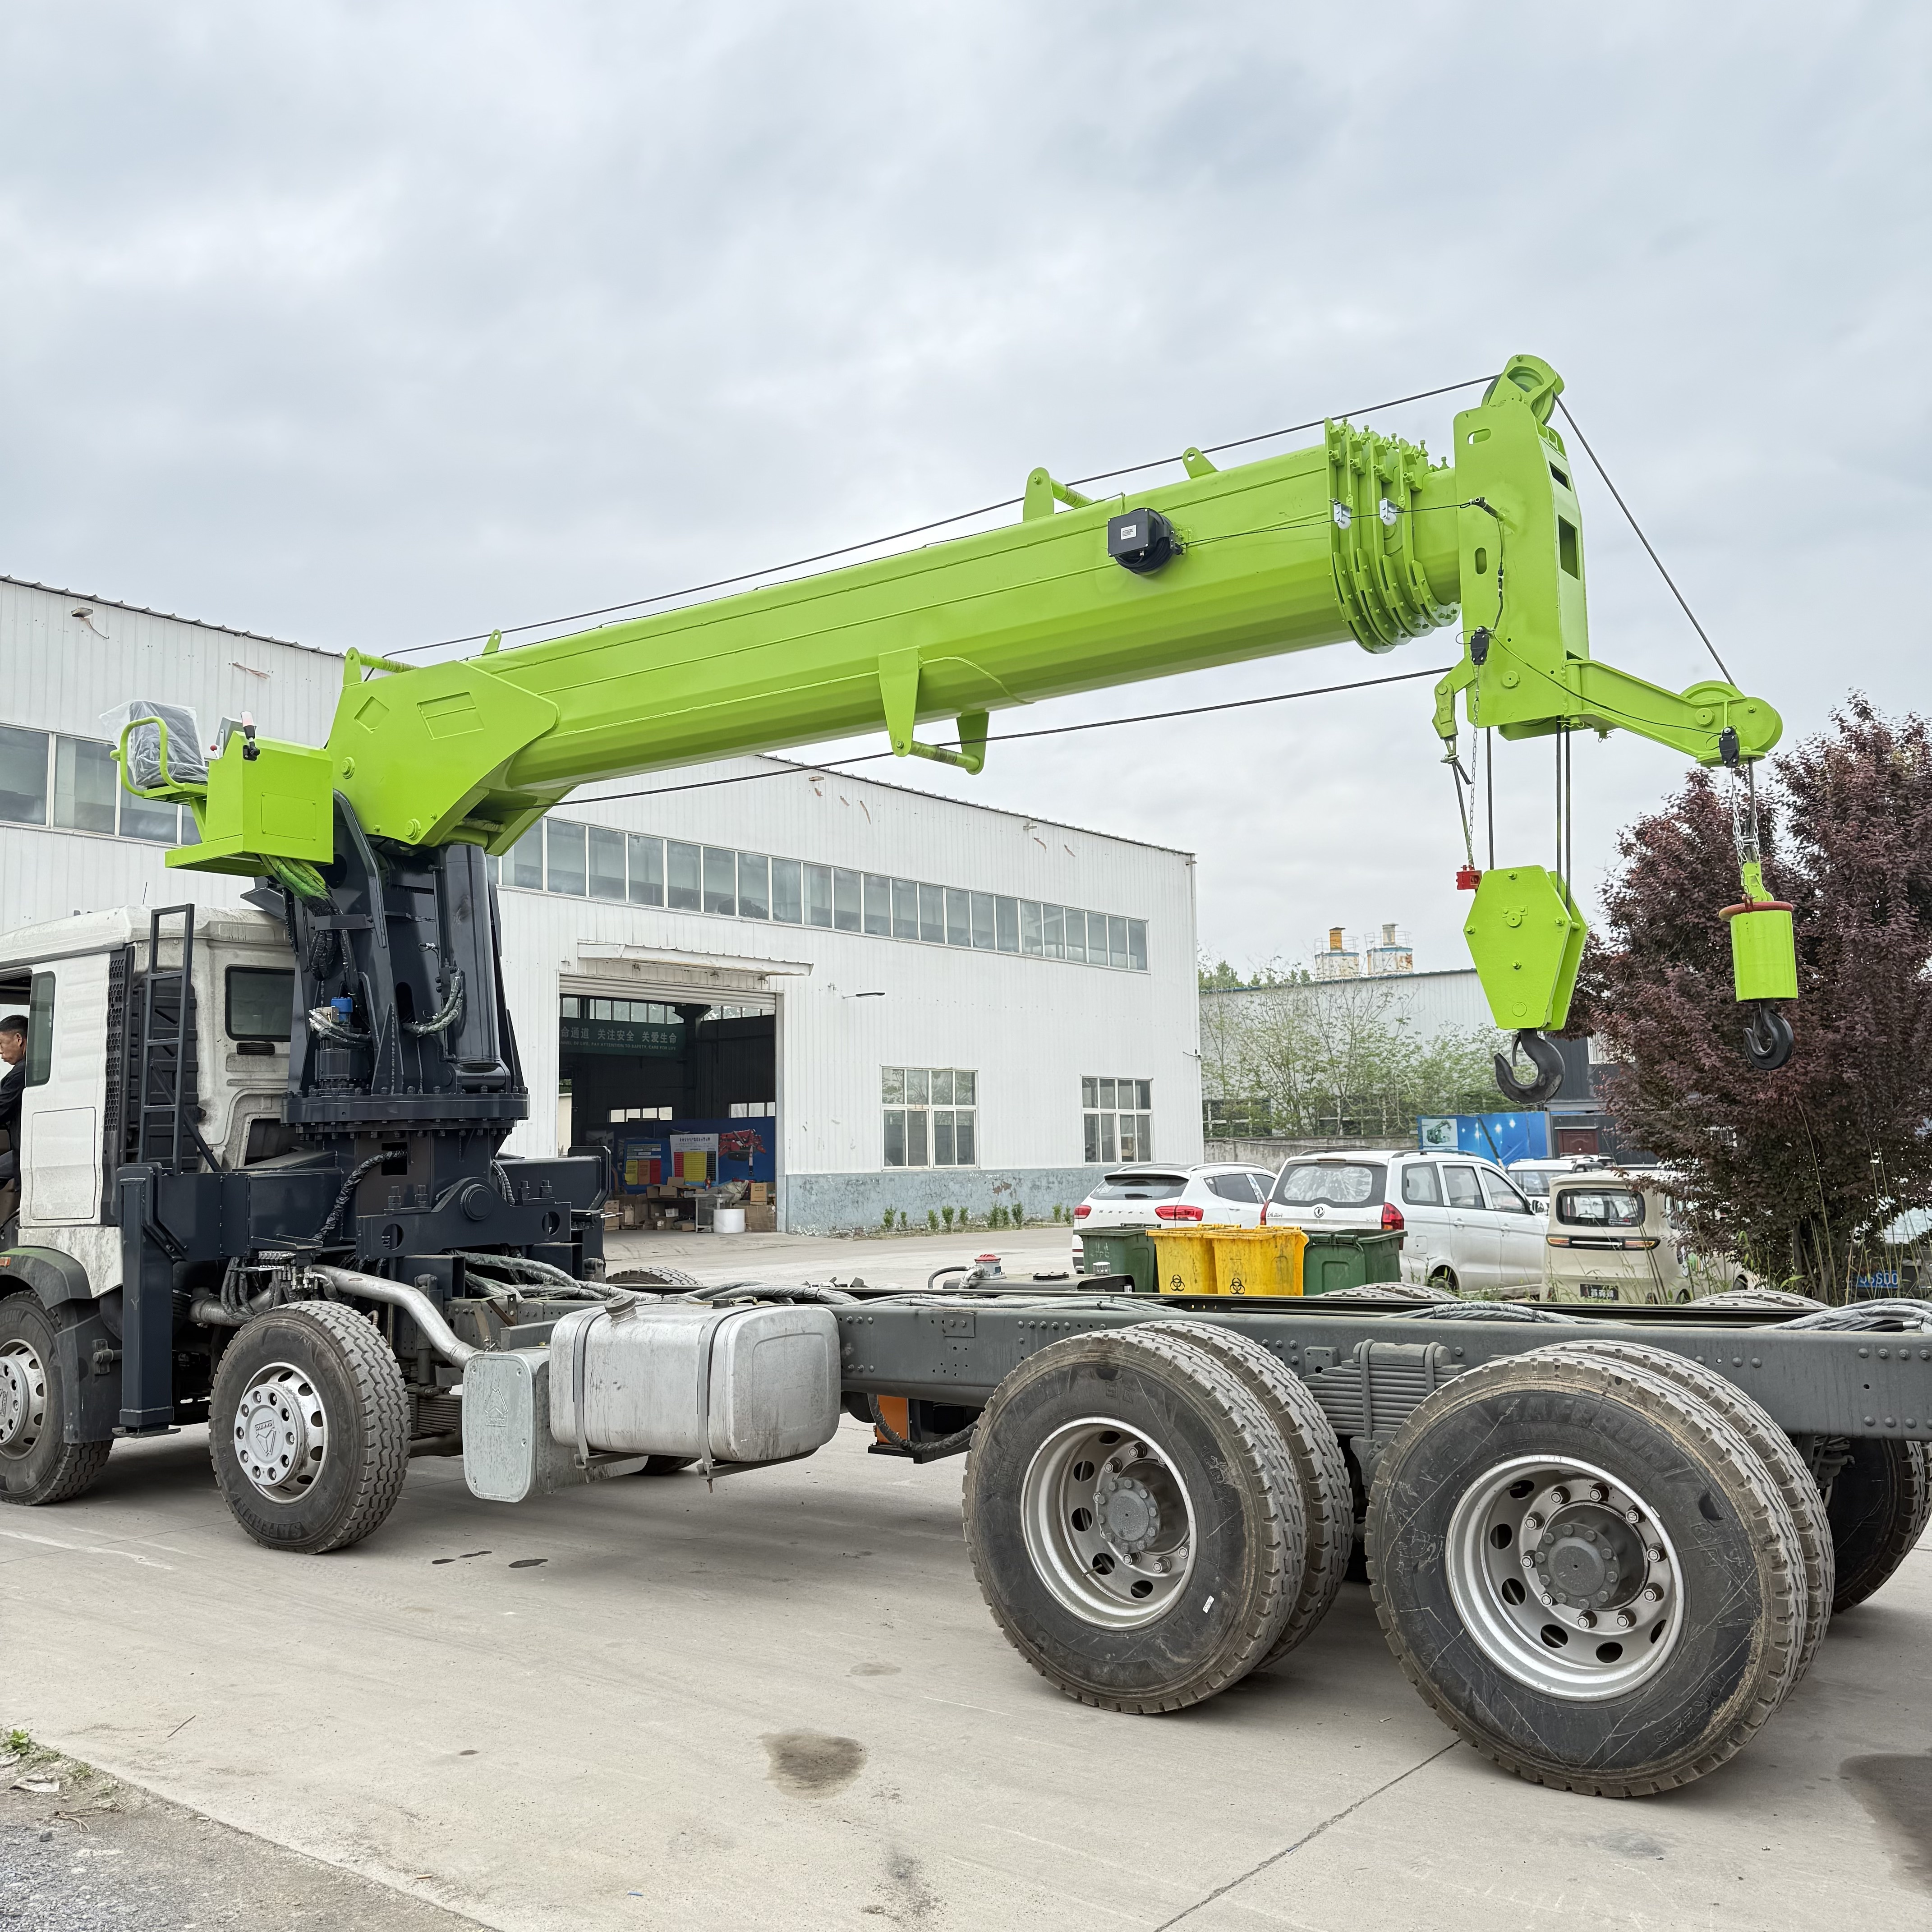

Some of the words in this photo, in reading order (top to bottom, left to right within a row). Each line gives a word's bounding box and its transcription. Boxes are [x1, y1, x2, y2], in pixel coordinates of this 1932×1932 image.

[561, 1026, 589, 1039] 命通道
[598, 1029, 634, 1041] 关注安全
[642, 1031, 677, 1044] 关爱生命
[235, 1499, 302, 1539] SAFERUN
[1654, 1674, 1725, 1748] 12R22.5
